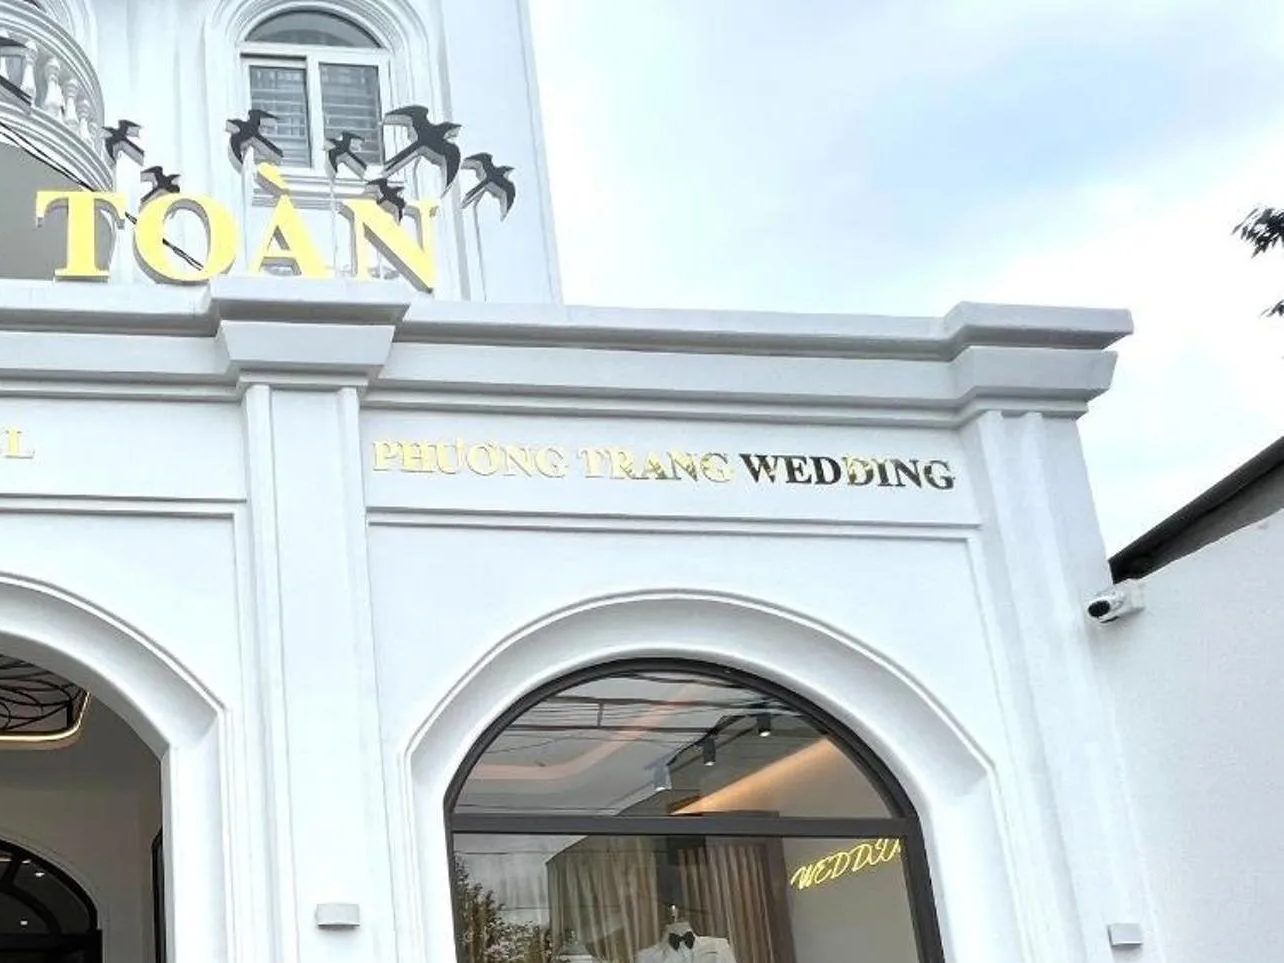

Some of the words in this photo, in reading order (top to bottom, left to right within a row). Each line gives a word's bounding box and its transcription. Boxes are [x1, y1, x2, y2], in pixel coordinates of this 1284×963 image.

[36, 161, 437, 294] TOÀN
[576, 447, 735, 483] TRANG
[738, 452, 956, 490] WEDDING
